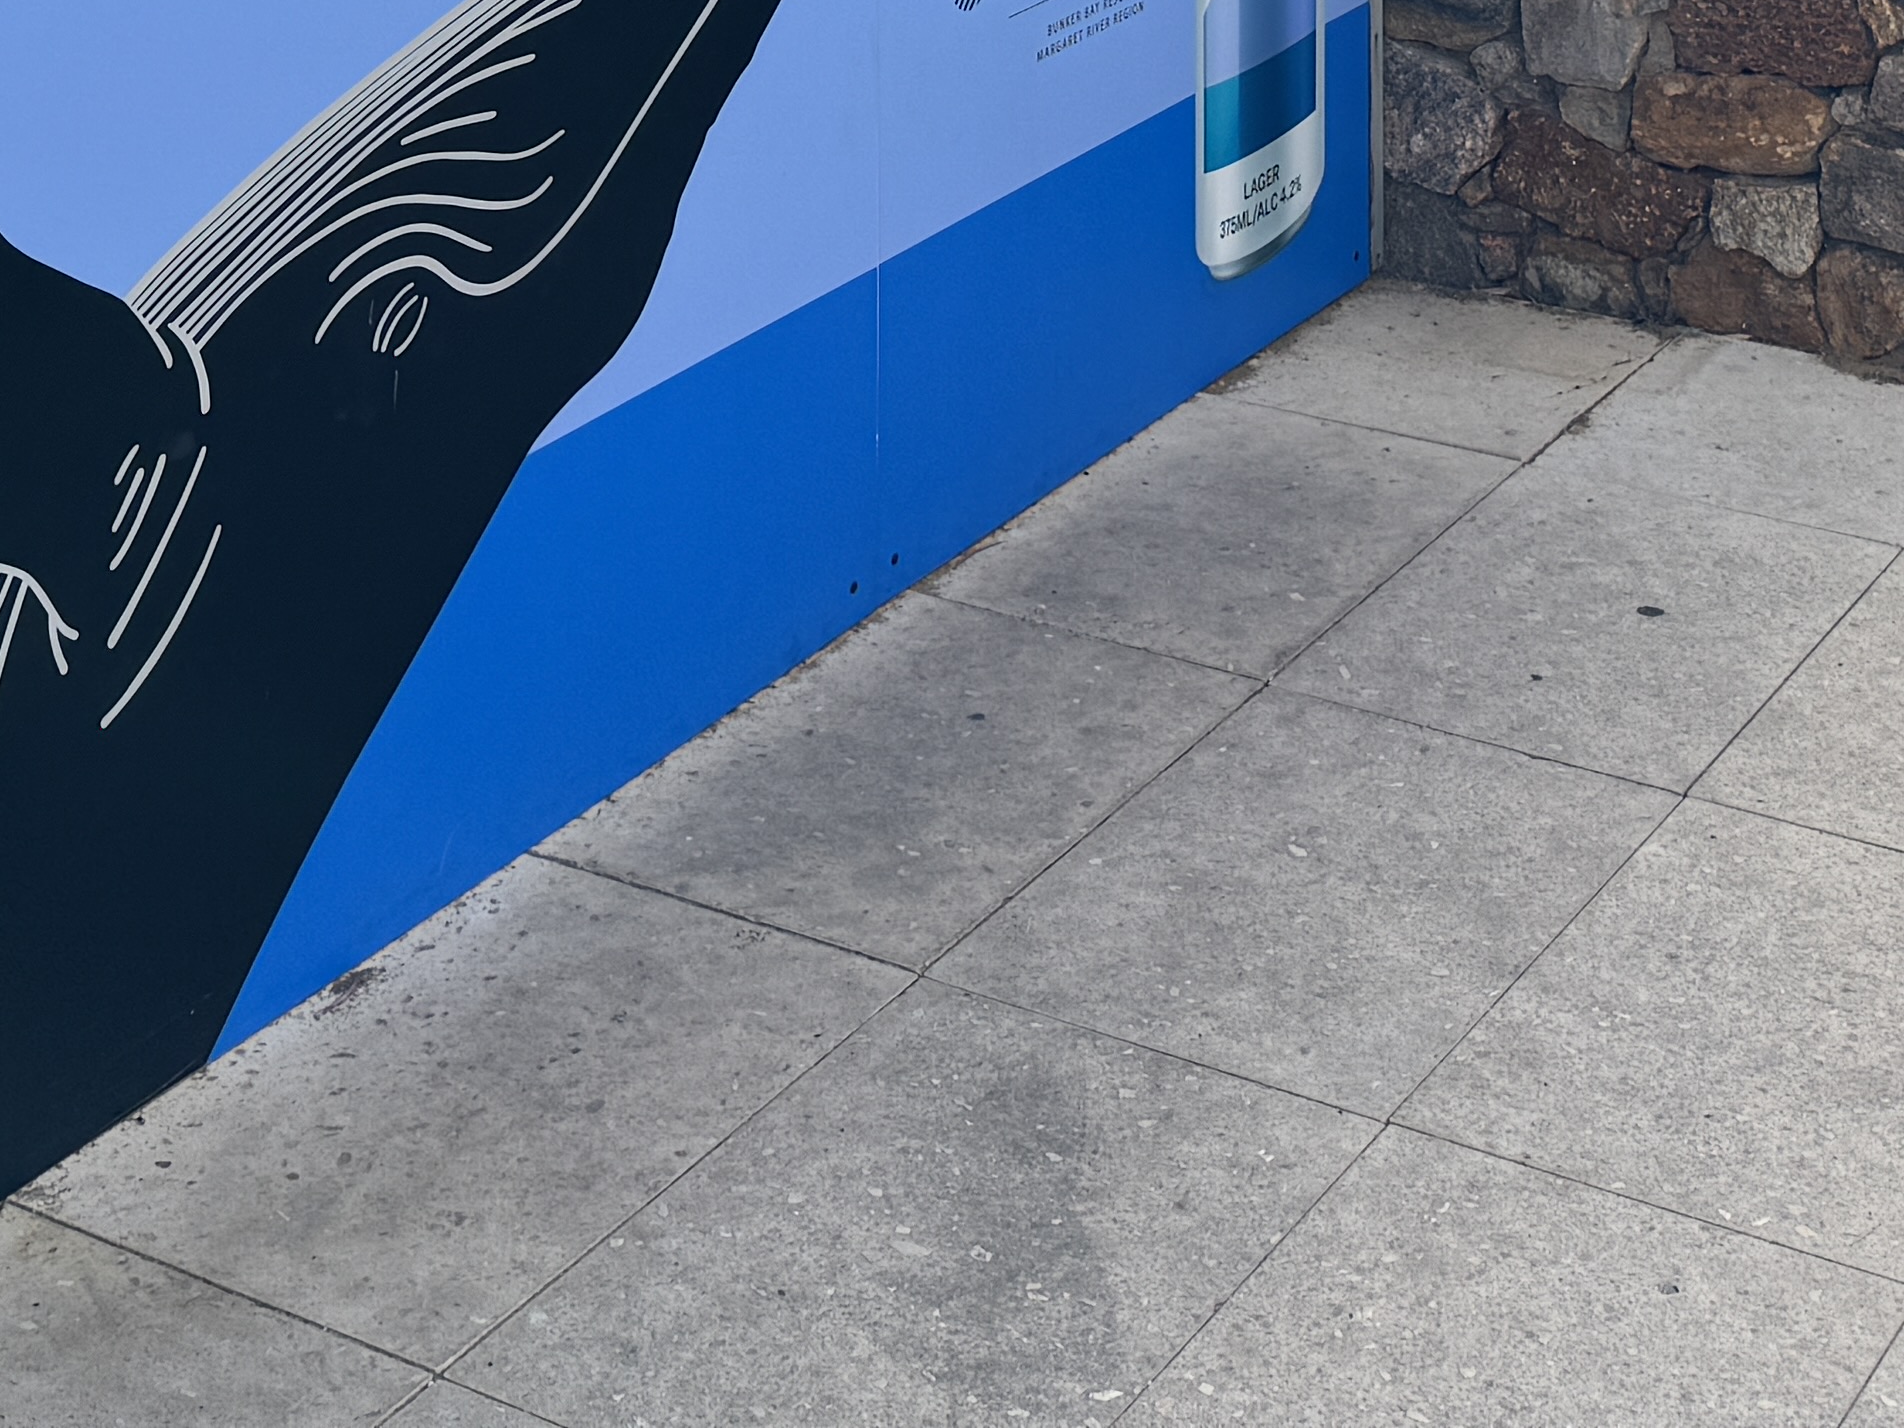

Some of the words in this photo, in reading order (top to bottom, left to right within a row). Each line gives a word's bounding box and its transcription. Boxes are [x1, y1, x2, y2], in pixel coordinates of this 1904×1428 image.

[1036, 29, 1084, 63] MARGARET
[1086, 18, 1111, 38] RIVER
[1112, 1, 1145, 25] REGION
[1046, 10, 1082, 37] BUNKER
[1084, 1, 1100, 20] BAY
[1243, 163, 1281, 200] LAGER
[1219, 191, 1279, 240] 375ML/ALC
[1279, 173, 1302, 205] 4.2%
